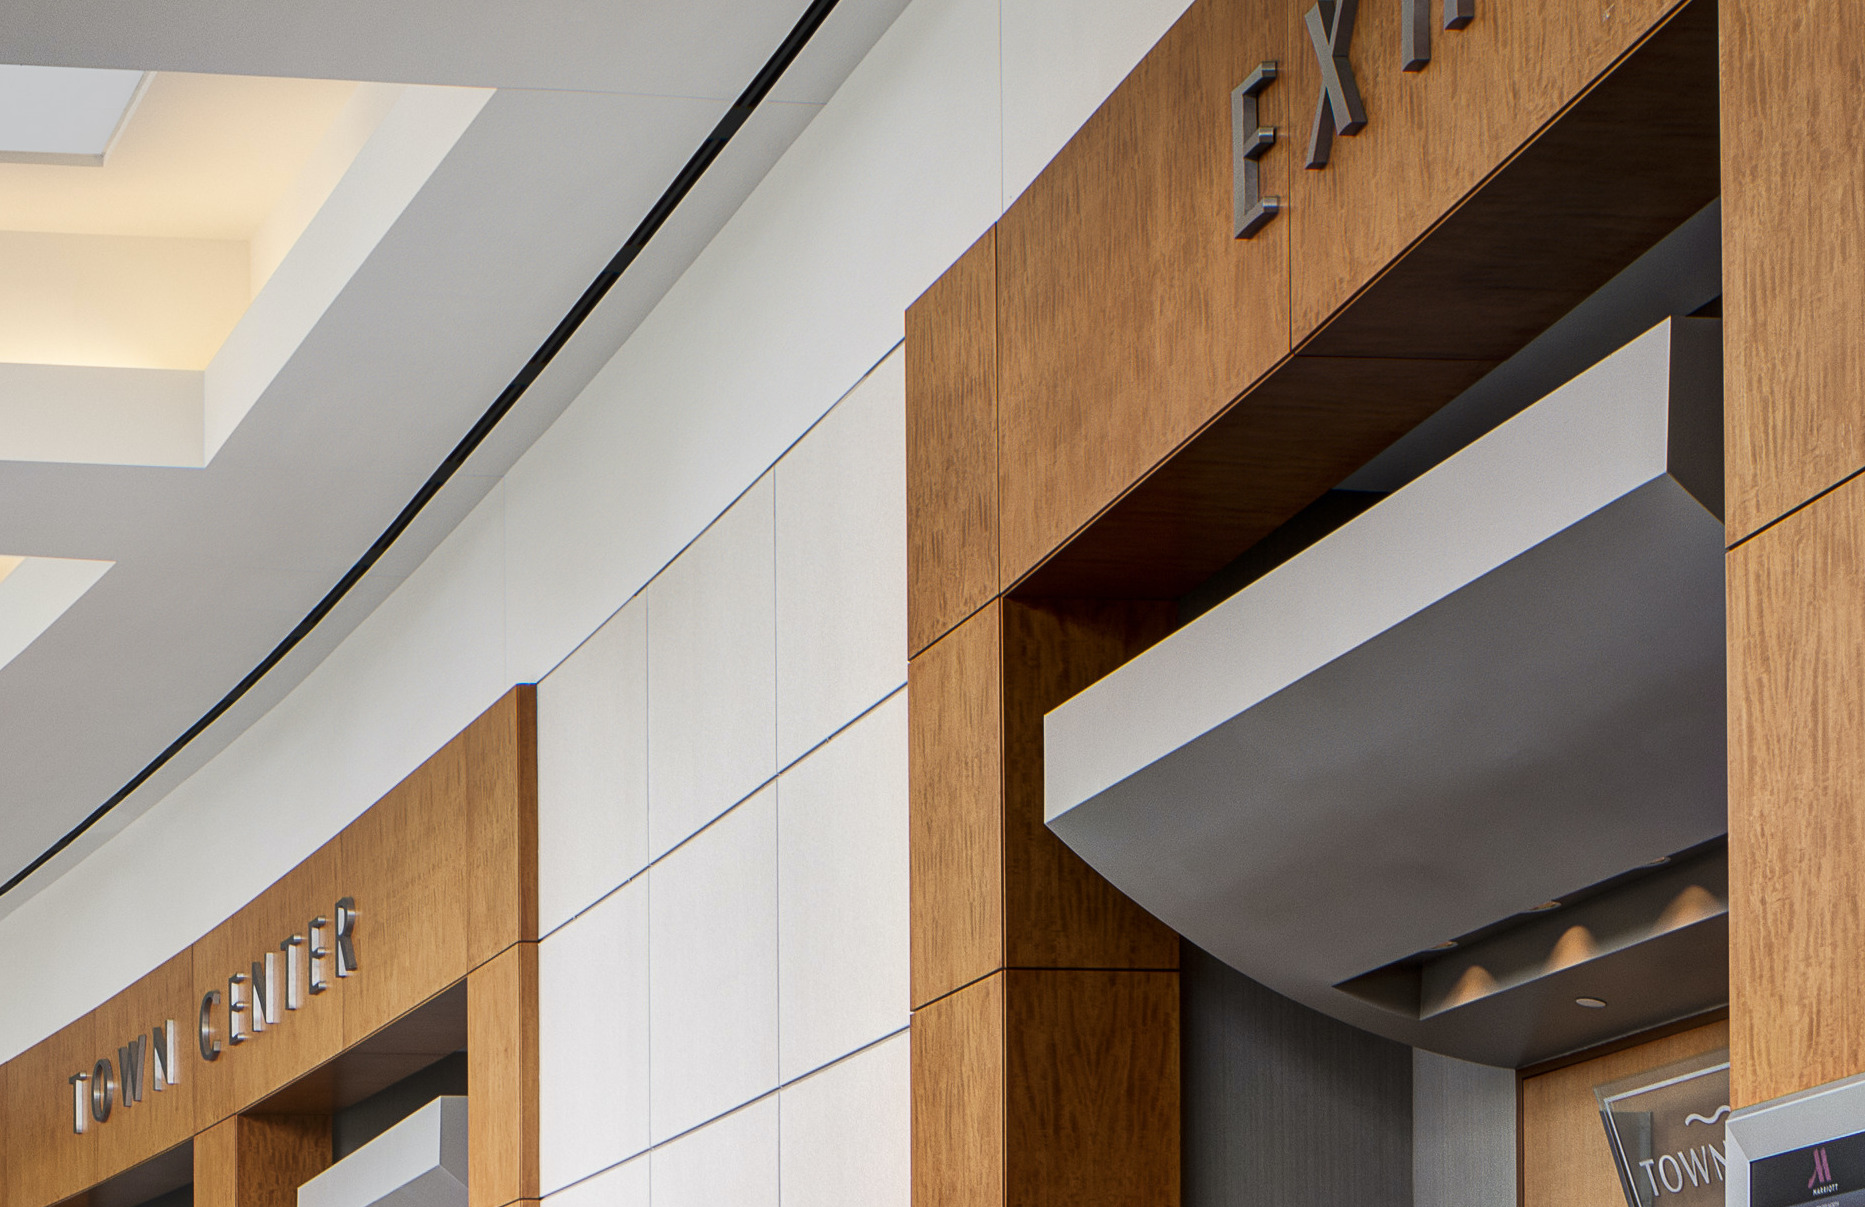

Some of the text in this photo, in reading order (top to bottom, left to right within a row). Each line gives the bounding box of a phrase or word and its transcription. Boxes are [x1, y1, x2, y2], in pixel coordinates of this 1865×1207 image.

[68, 896, 358, 1134] TOWN CENTER
[1812, 1183, 1839, 1196] MARRIOTT
